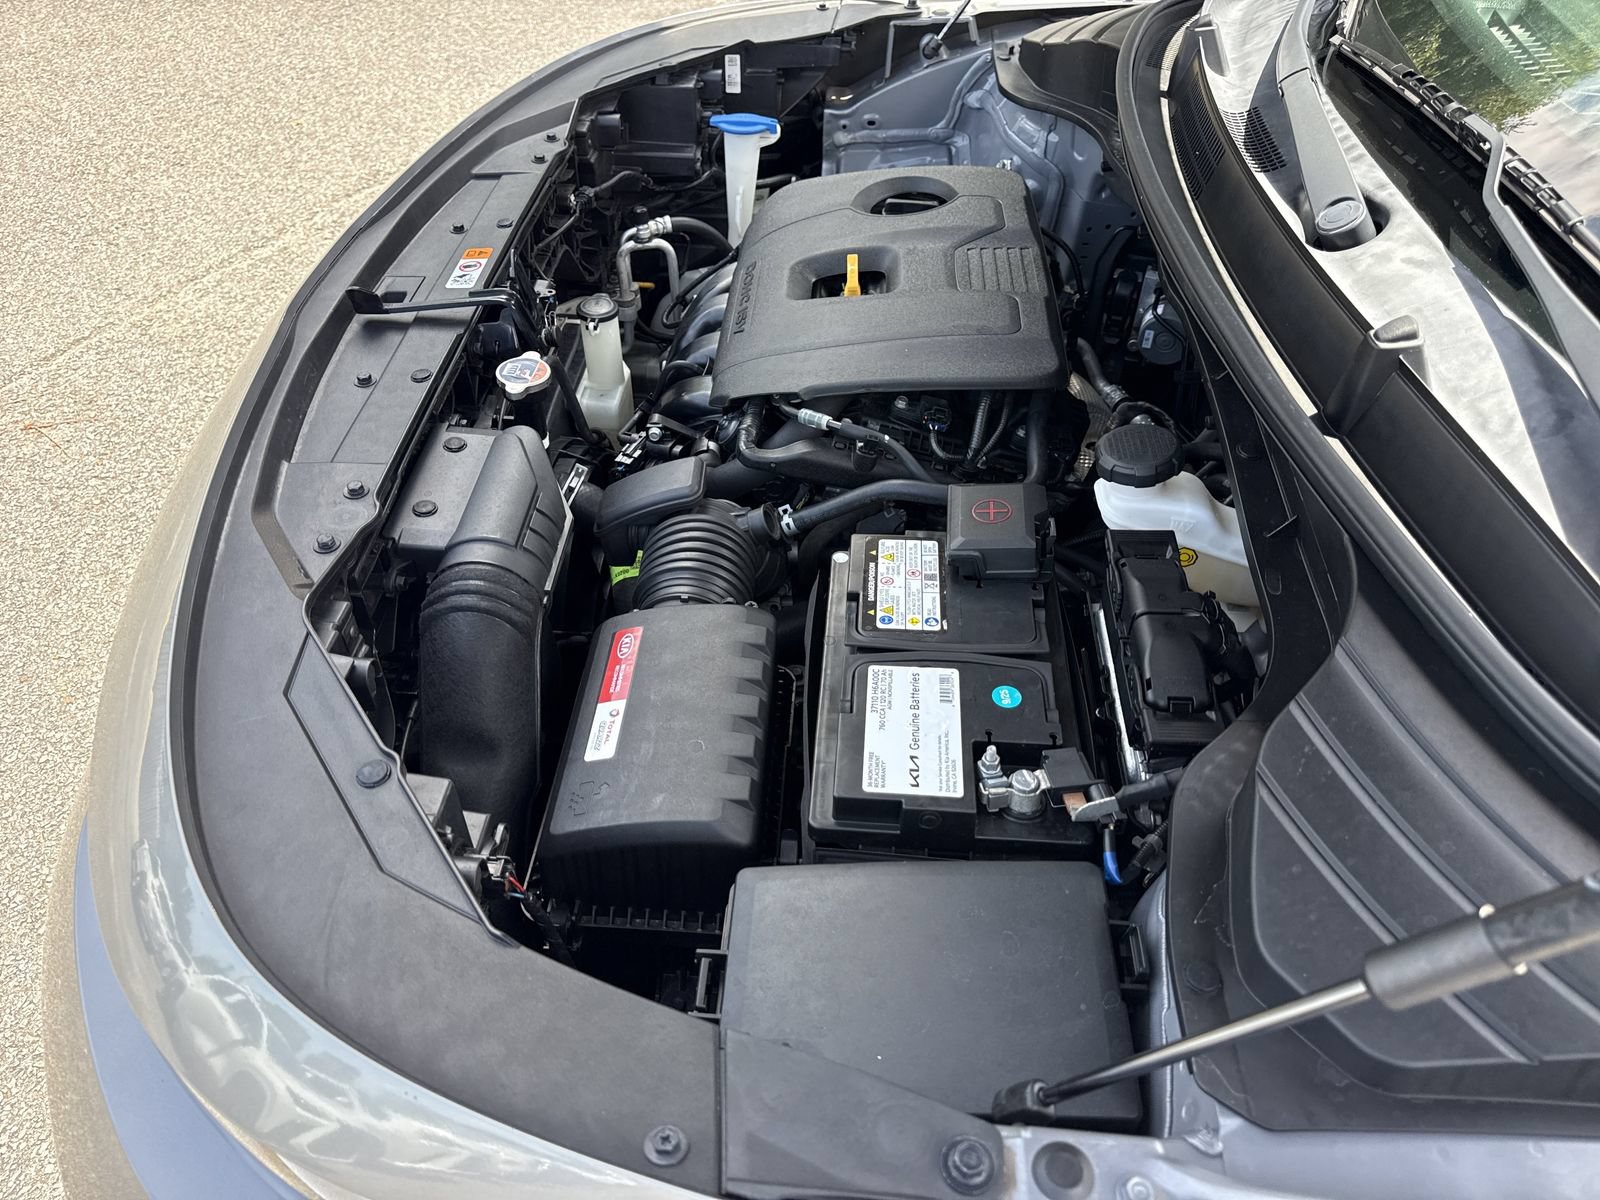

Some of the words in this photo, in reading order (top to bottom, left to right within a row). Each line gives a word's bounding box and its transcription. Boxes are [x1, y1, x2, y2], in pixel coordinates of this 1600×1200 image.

[620, 636, 632, 656] KIA
[872, 669, 880, 694] H6A00C
[910, 673, 920, 710] Batteries
[604, 719, 615, 744] TOTAL
[909, 713, 920, 750] Genuine
[909, 755, 919, 787] KIA
